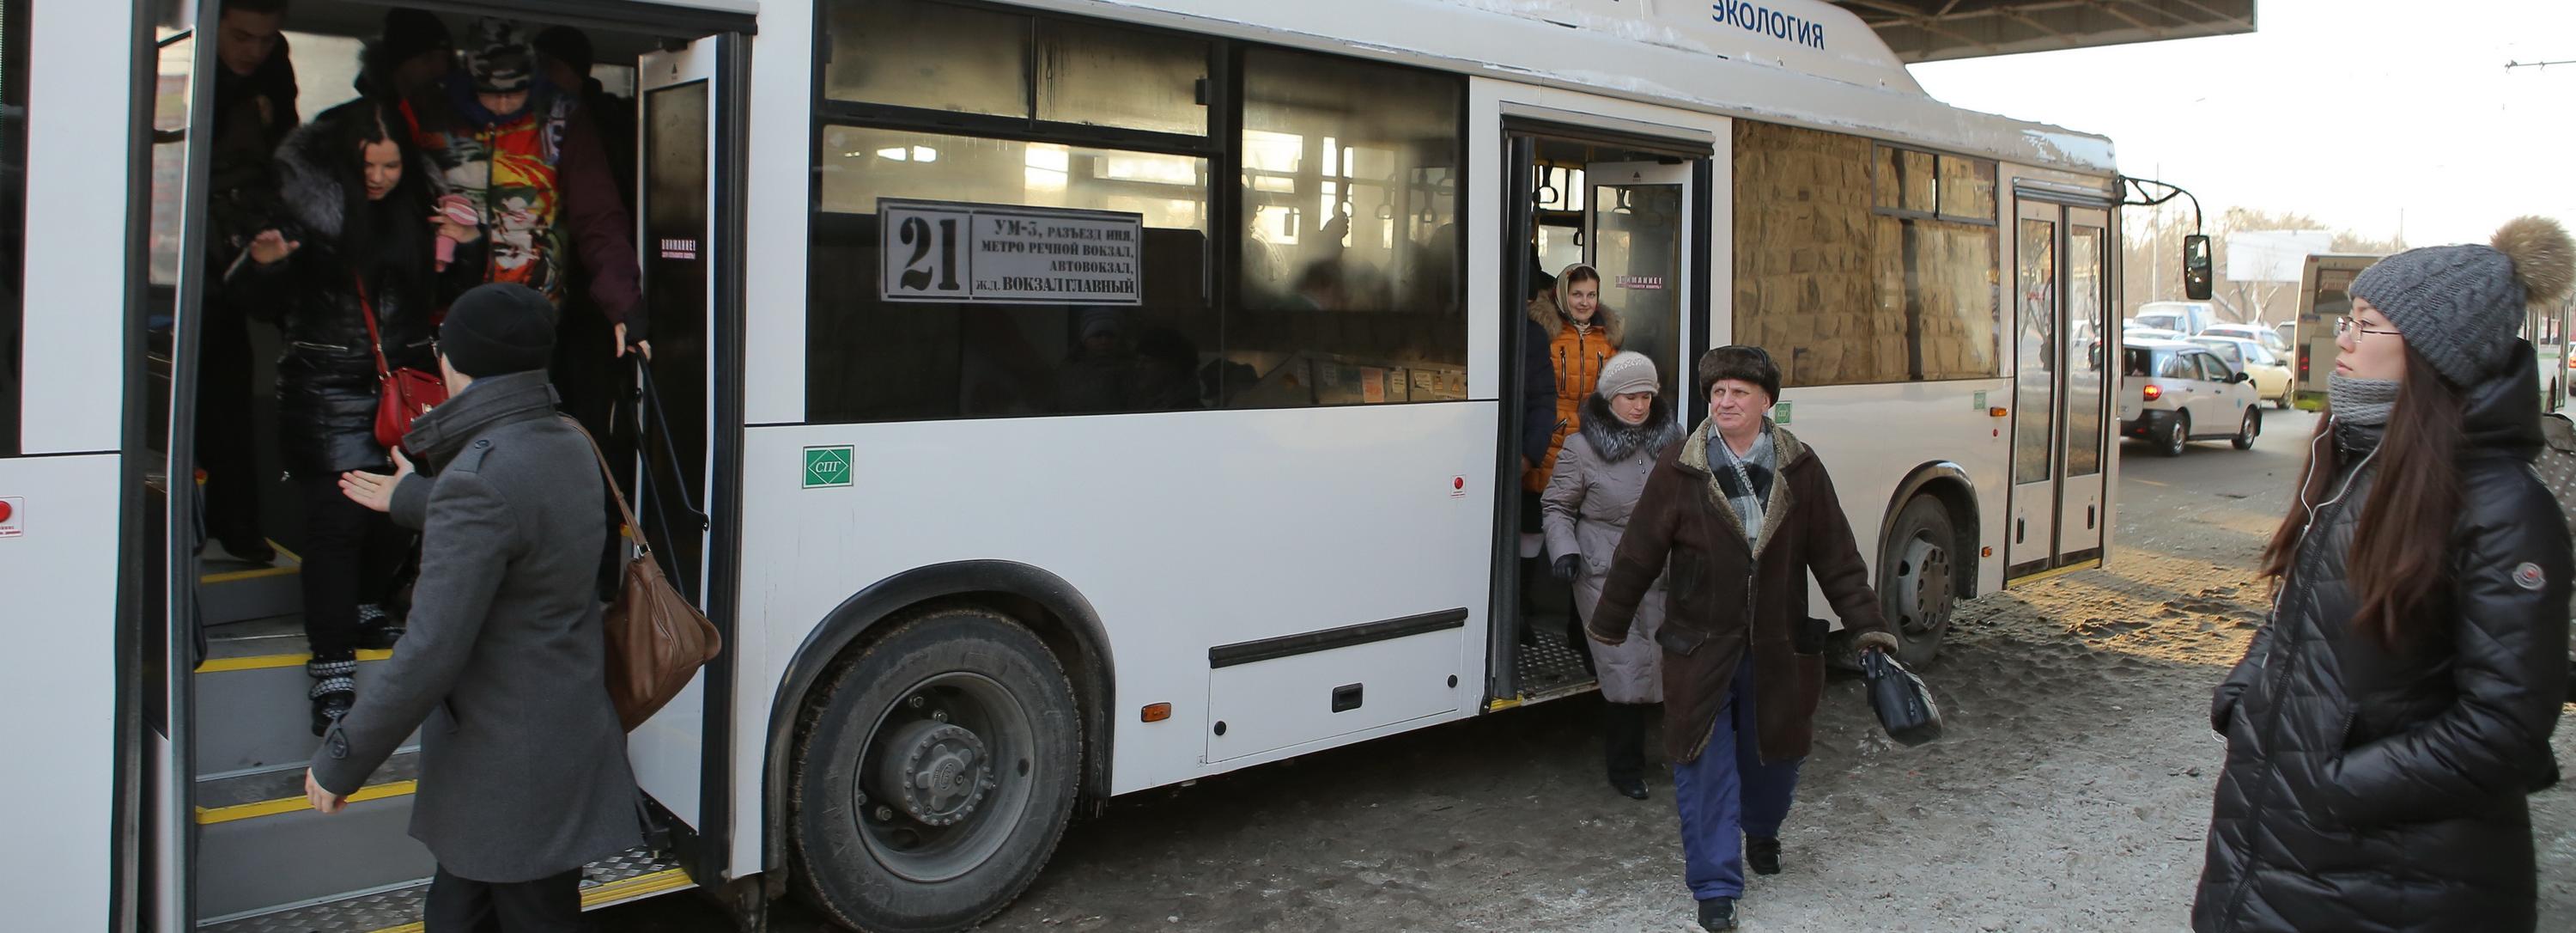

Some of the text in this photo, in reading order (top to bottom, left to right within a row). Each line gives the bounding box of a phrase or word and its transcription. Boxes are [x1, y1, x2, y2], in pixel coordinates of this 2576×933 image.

[1711, 0, 1825, 50] ЭКОЛОГИЯ
[994, 219, 1134, 243] УМ-3, РАЗЪЕЗД ИНЯ,
[899, 216, 961, 291] 21
[981, 241, 1134, 259] МЕТРО РЕЧНОЙ ВОКЗАЛ,
[1049, 260, 1134, 276] АВТОВОКЗАЛ,
[1003, 277, 1063, 293] ВОКЗАЛ
[1065, 277, 1134, 294] ГЛАВНЫЙ
[815, 460, 841, 473] СПГ
